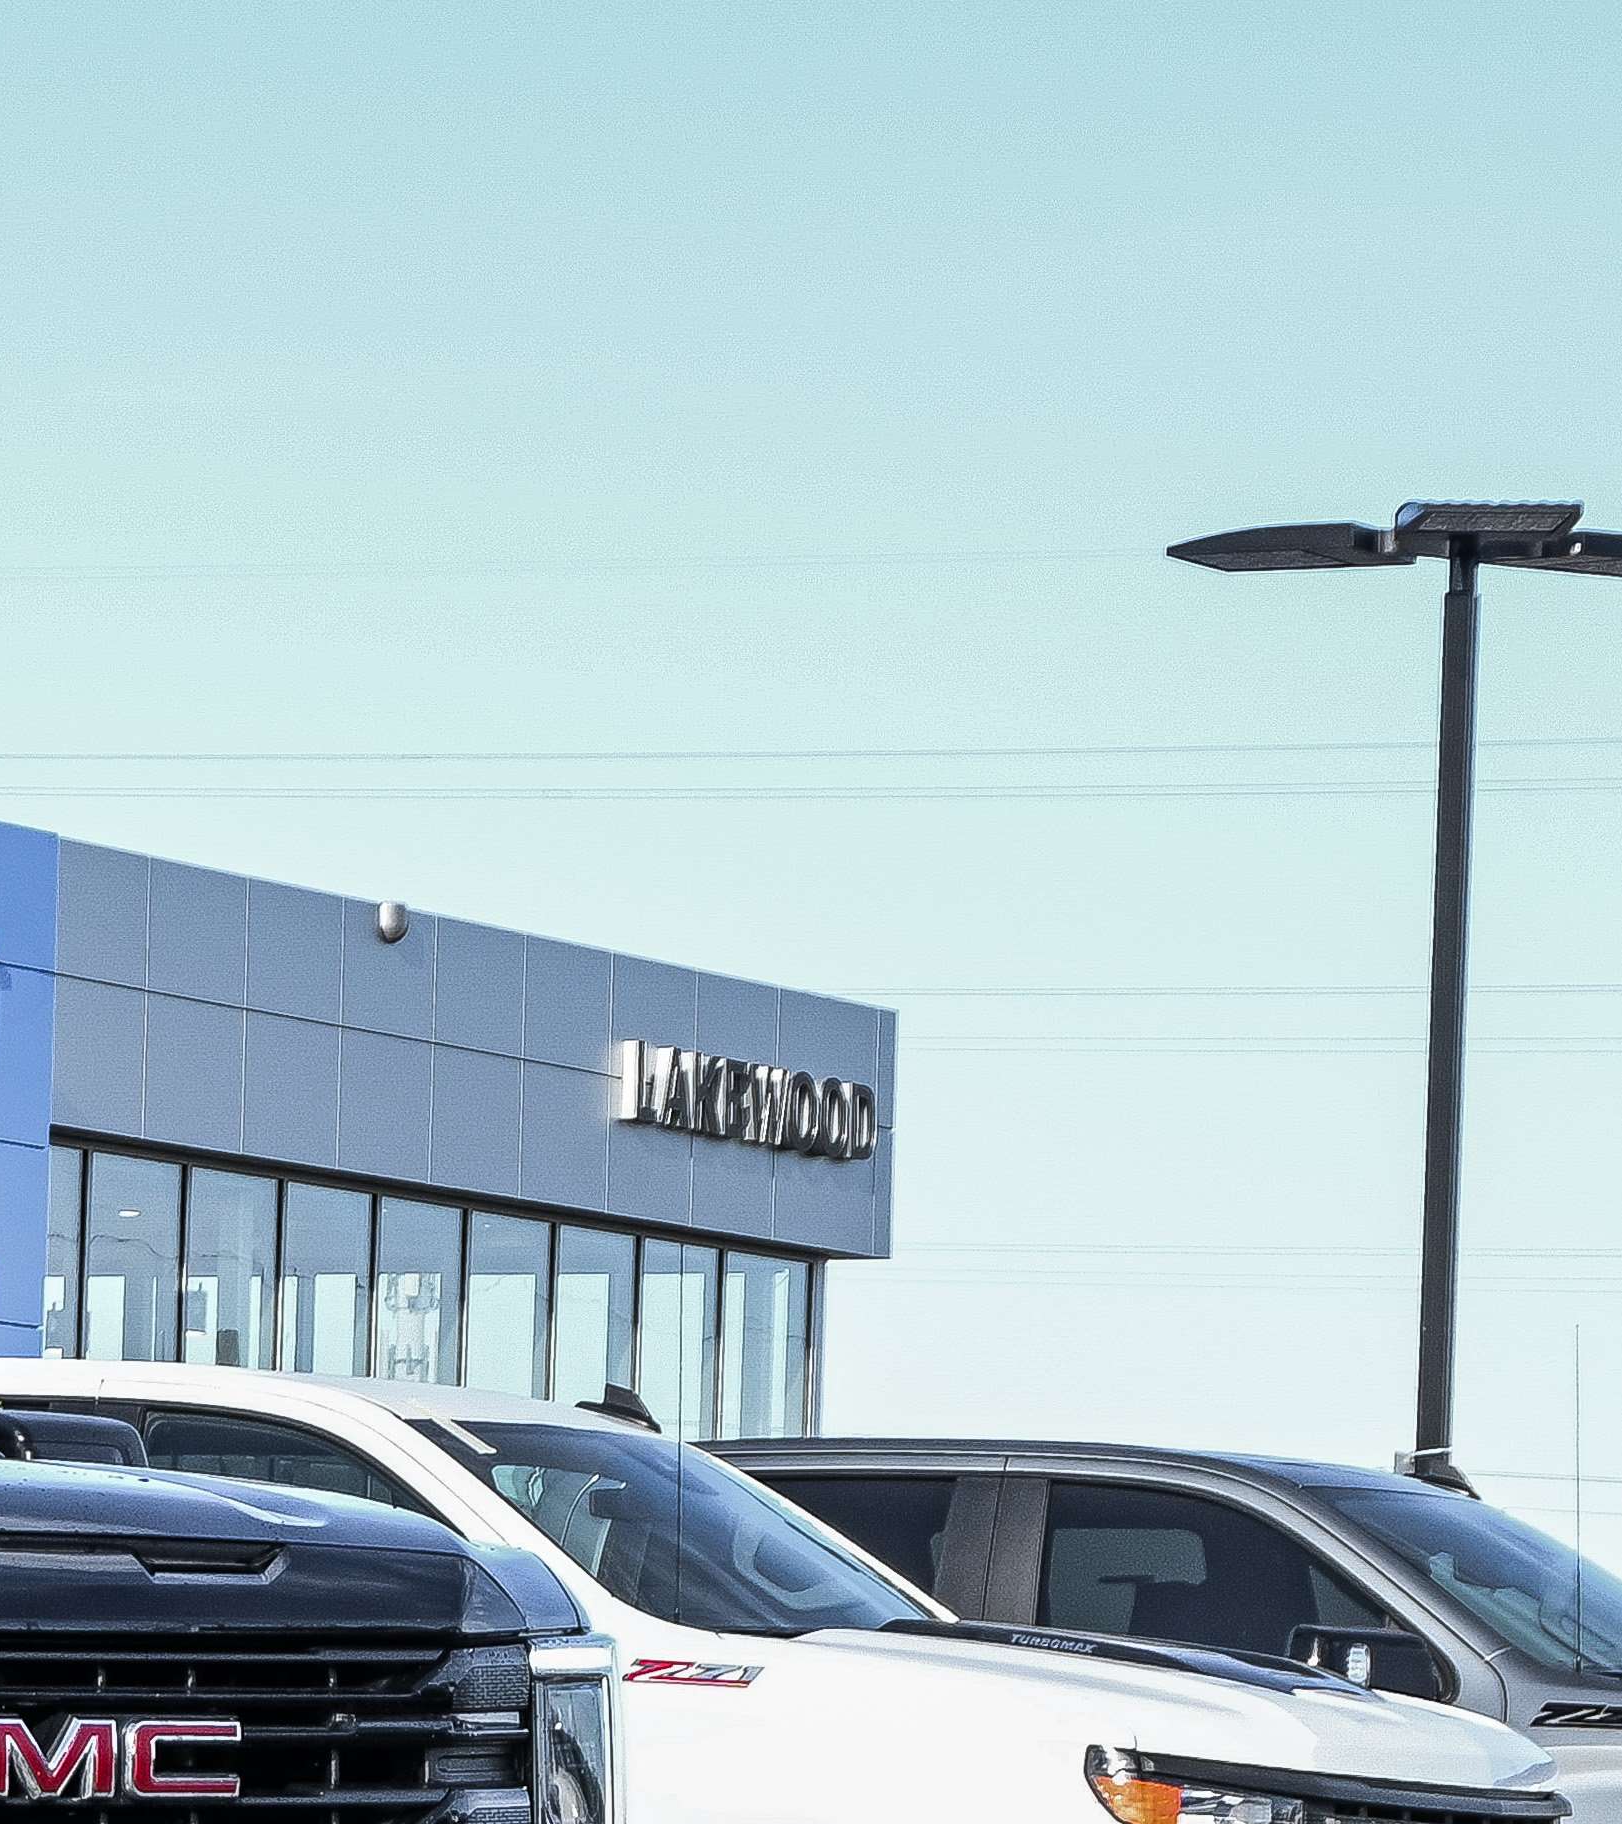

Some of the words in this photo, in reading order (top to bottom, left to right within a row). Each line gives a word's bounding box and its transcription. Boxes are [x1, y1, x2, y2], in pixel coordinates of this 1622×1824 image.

[620, 1040, 877, 1159] LAKEWOOD
[1011, 1633, 1098, 1653] TURBOMAX
[622, 1658, 766, 1688] Z71
